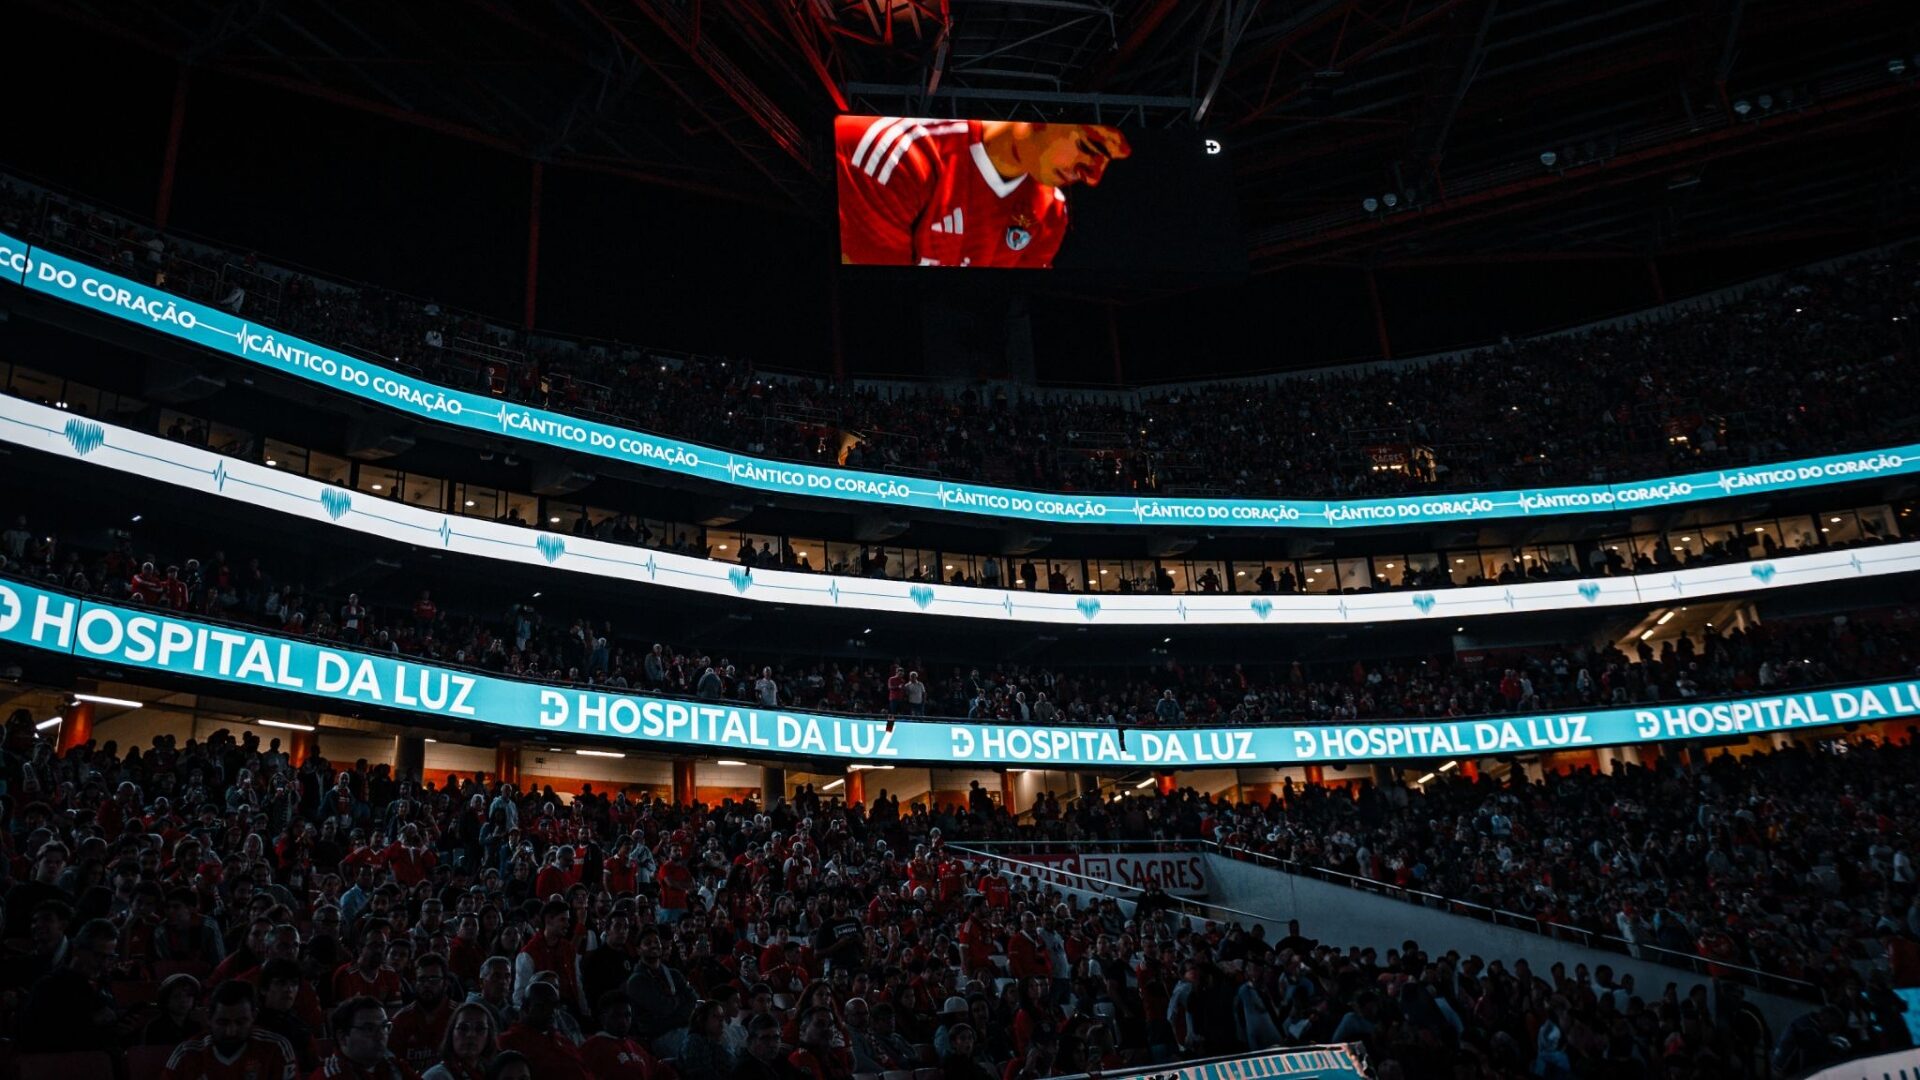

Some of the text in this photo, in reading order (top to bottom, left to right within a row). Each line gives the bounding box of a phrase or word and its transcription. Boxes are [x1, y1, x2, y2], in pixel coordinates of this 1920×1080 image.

[39, 262, 77, 289] DO
[82, 278, 196, 328] CORAÇÃO
[249, 335, 462, 415] CÂNTICO DO CORAÇÃO
[508, 412, 698, 467] CÂNTICO DO CORAÇÃO
[735, 463, 910, 498] CÂNTICO DO CORAÇÃO
[1727, 455, 1902, 488] CÂNTICO DO CORAÇÃO
[946, 488, 1106, 518] CÂNTICO DO CORAÇÃO
[1142, 502, 1299, 522] CÂNTICO DO CORAÇÃO
[1331, 498, 1493, 521] CÂNTICO DO CORAÇÃO
[1527, 482, 1692, 508] CÂNTICO DO CORAÇÃO
[31, 595, 475, 716] HOSPITAL DA LUZ
[578, 694, 898, 756] HOSPITAL DA LUZ
[1663, 696, 1829, 736] HOSPITAL
[1831, 689, 1888, 719] DA
[981, 728, 1256, 762] HOSPITAL DA LUZ
[1321, 716, 1592, 758] HOSPITAL DA LUZ
[1117, 857, 1205, 891] SAGRES
